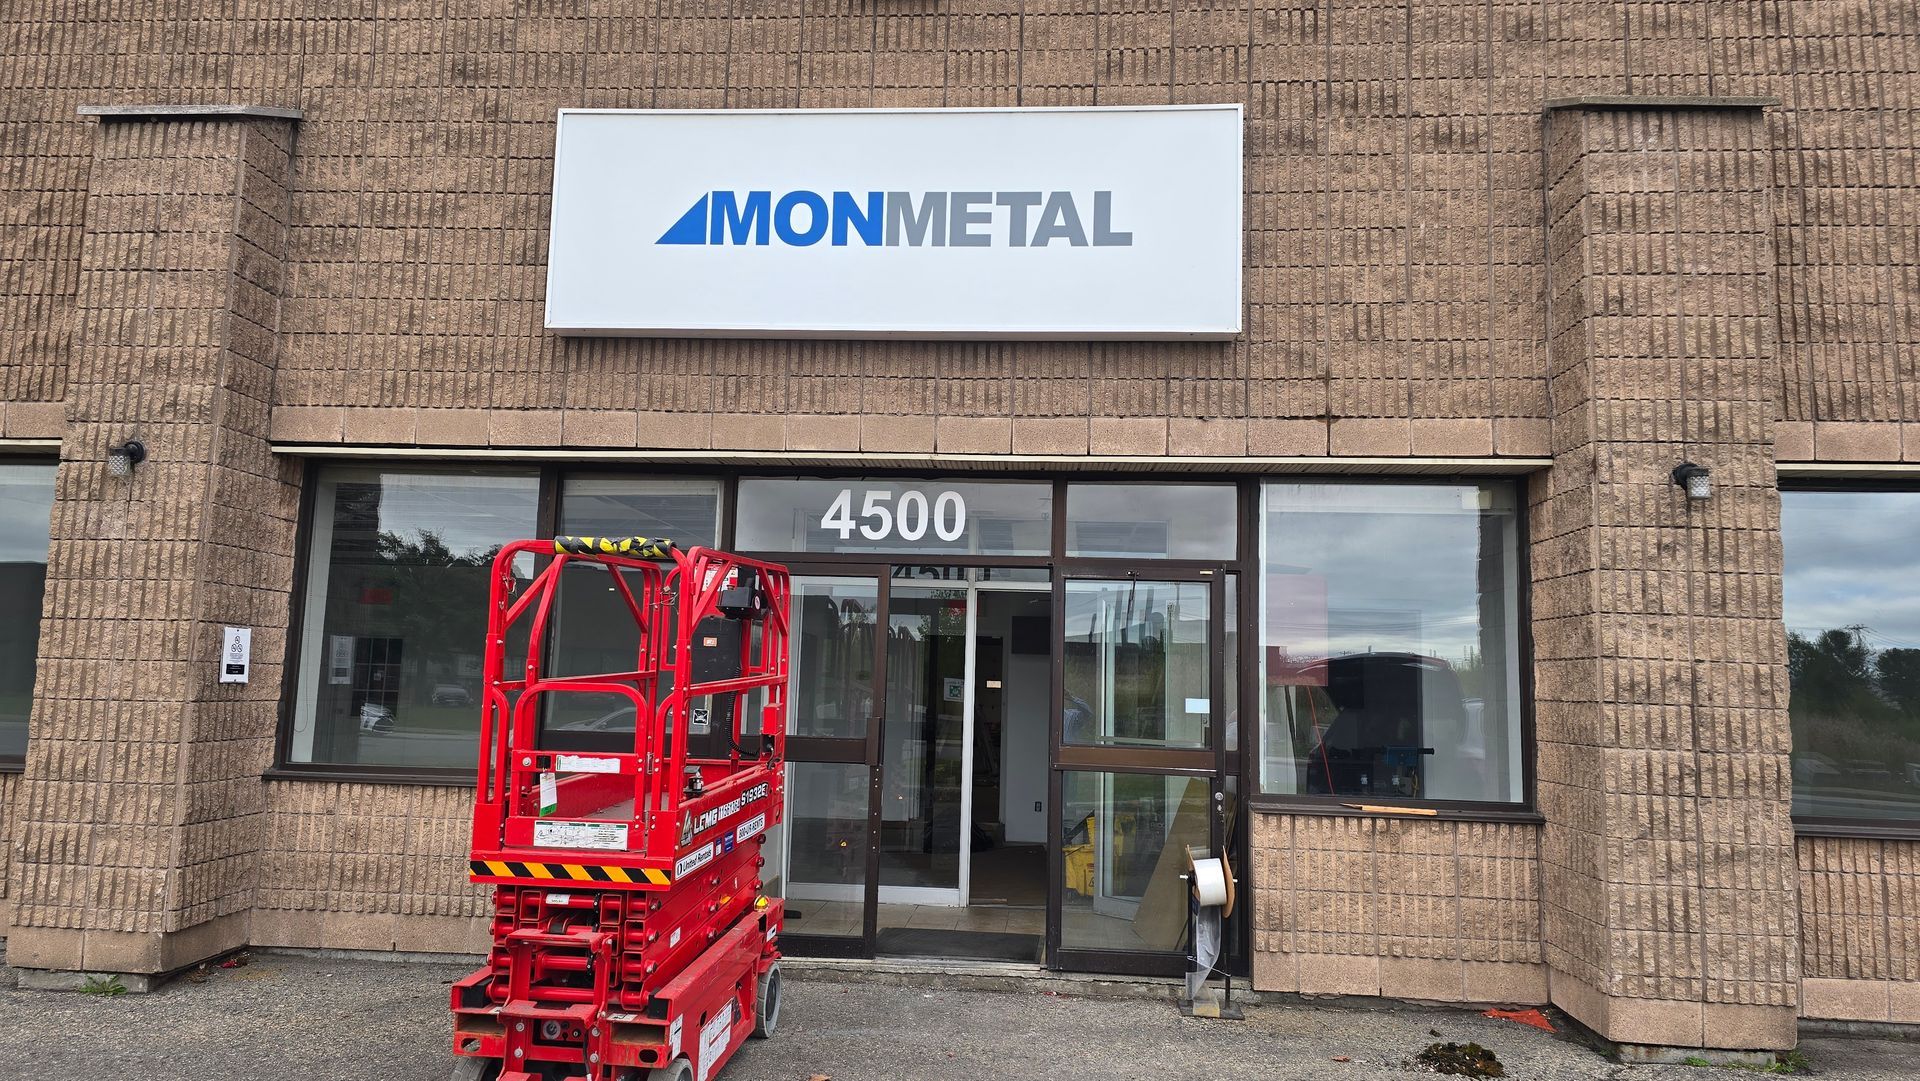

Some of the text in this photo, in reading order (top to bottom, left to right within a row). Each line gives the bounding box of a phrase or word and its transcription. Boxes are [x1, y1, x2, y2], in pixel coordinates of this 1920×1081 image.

[710, 190, 1133, 247] MONMETAL
[820, 489, 966, 541] 4500
[683, 849, 711, 872] United Rentals
